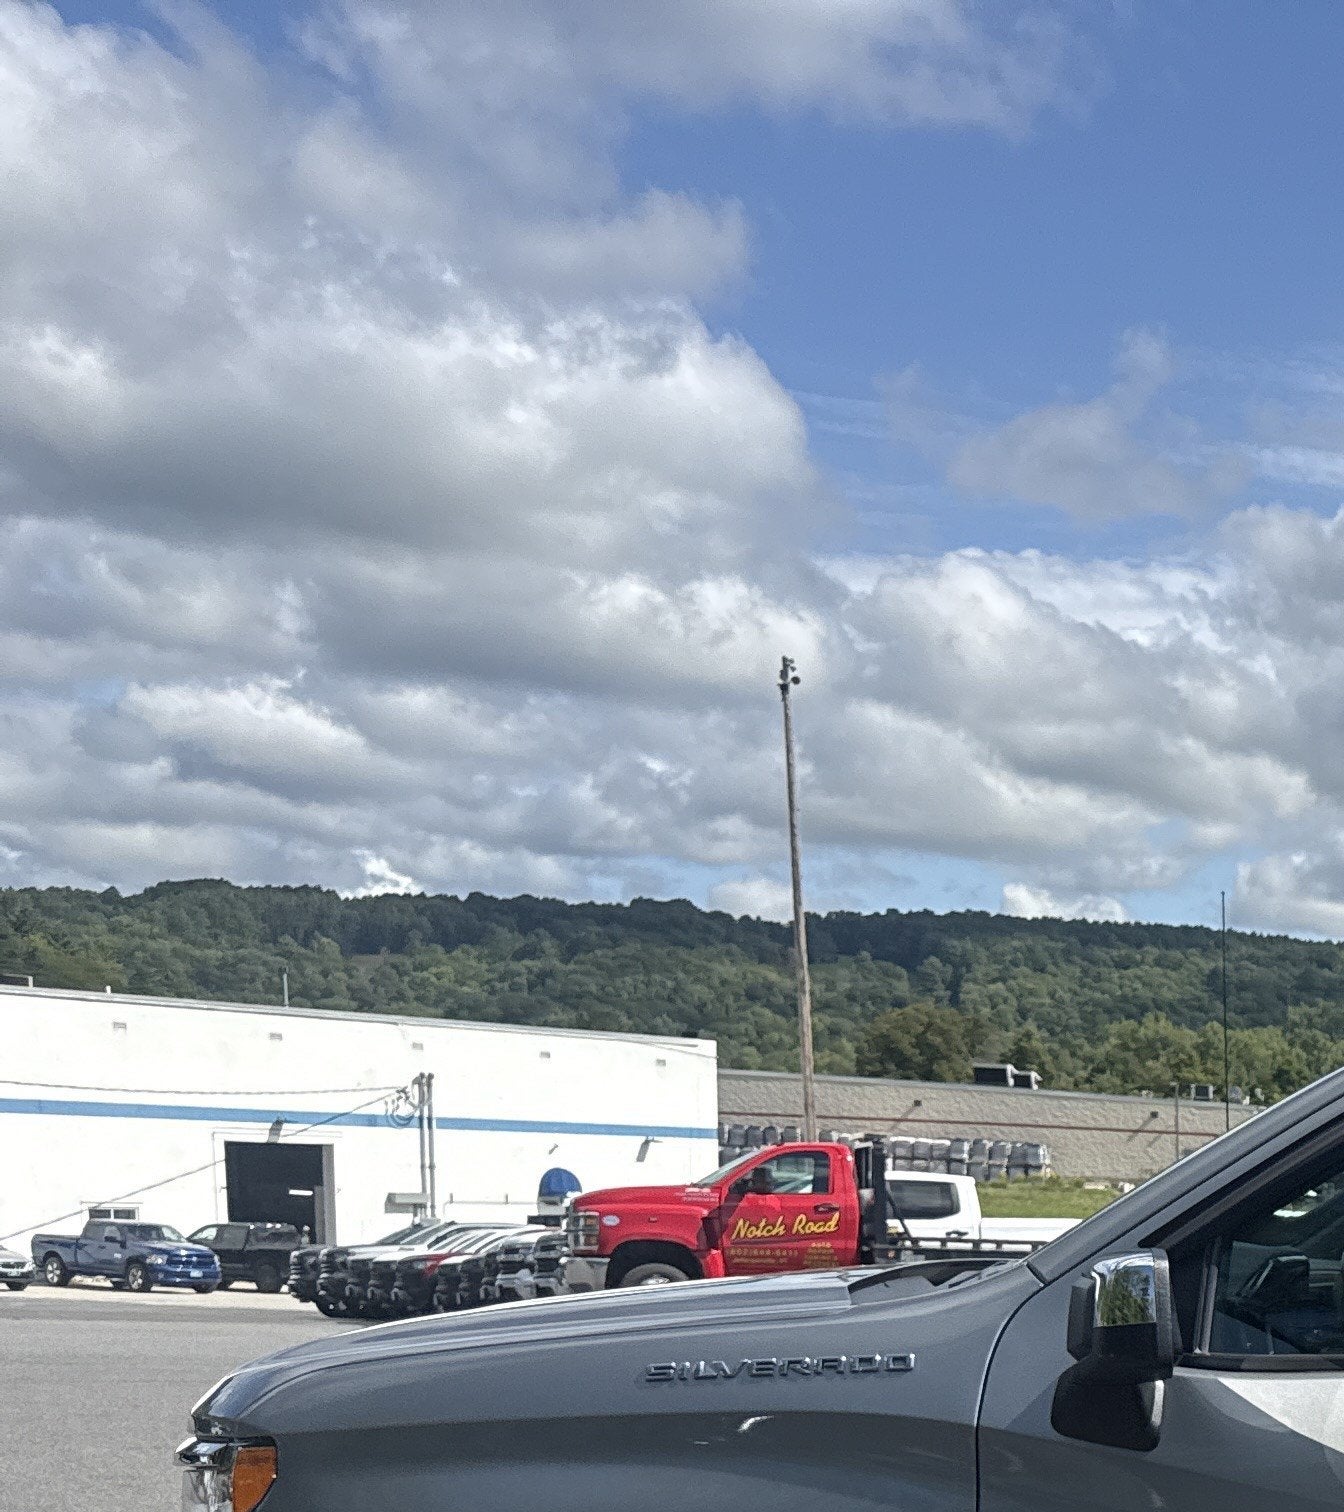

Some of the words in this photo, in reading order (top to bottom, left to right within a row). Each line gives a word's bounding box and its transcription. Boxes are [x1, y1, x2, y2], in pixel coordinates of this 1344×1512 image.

[730, 1215, 786, 1240] Notch
[791, 1211, 841, 1235] Road
[645, 1353, 916, 1383] SILVERADO
